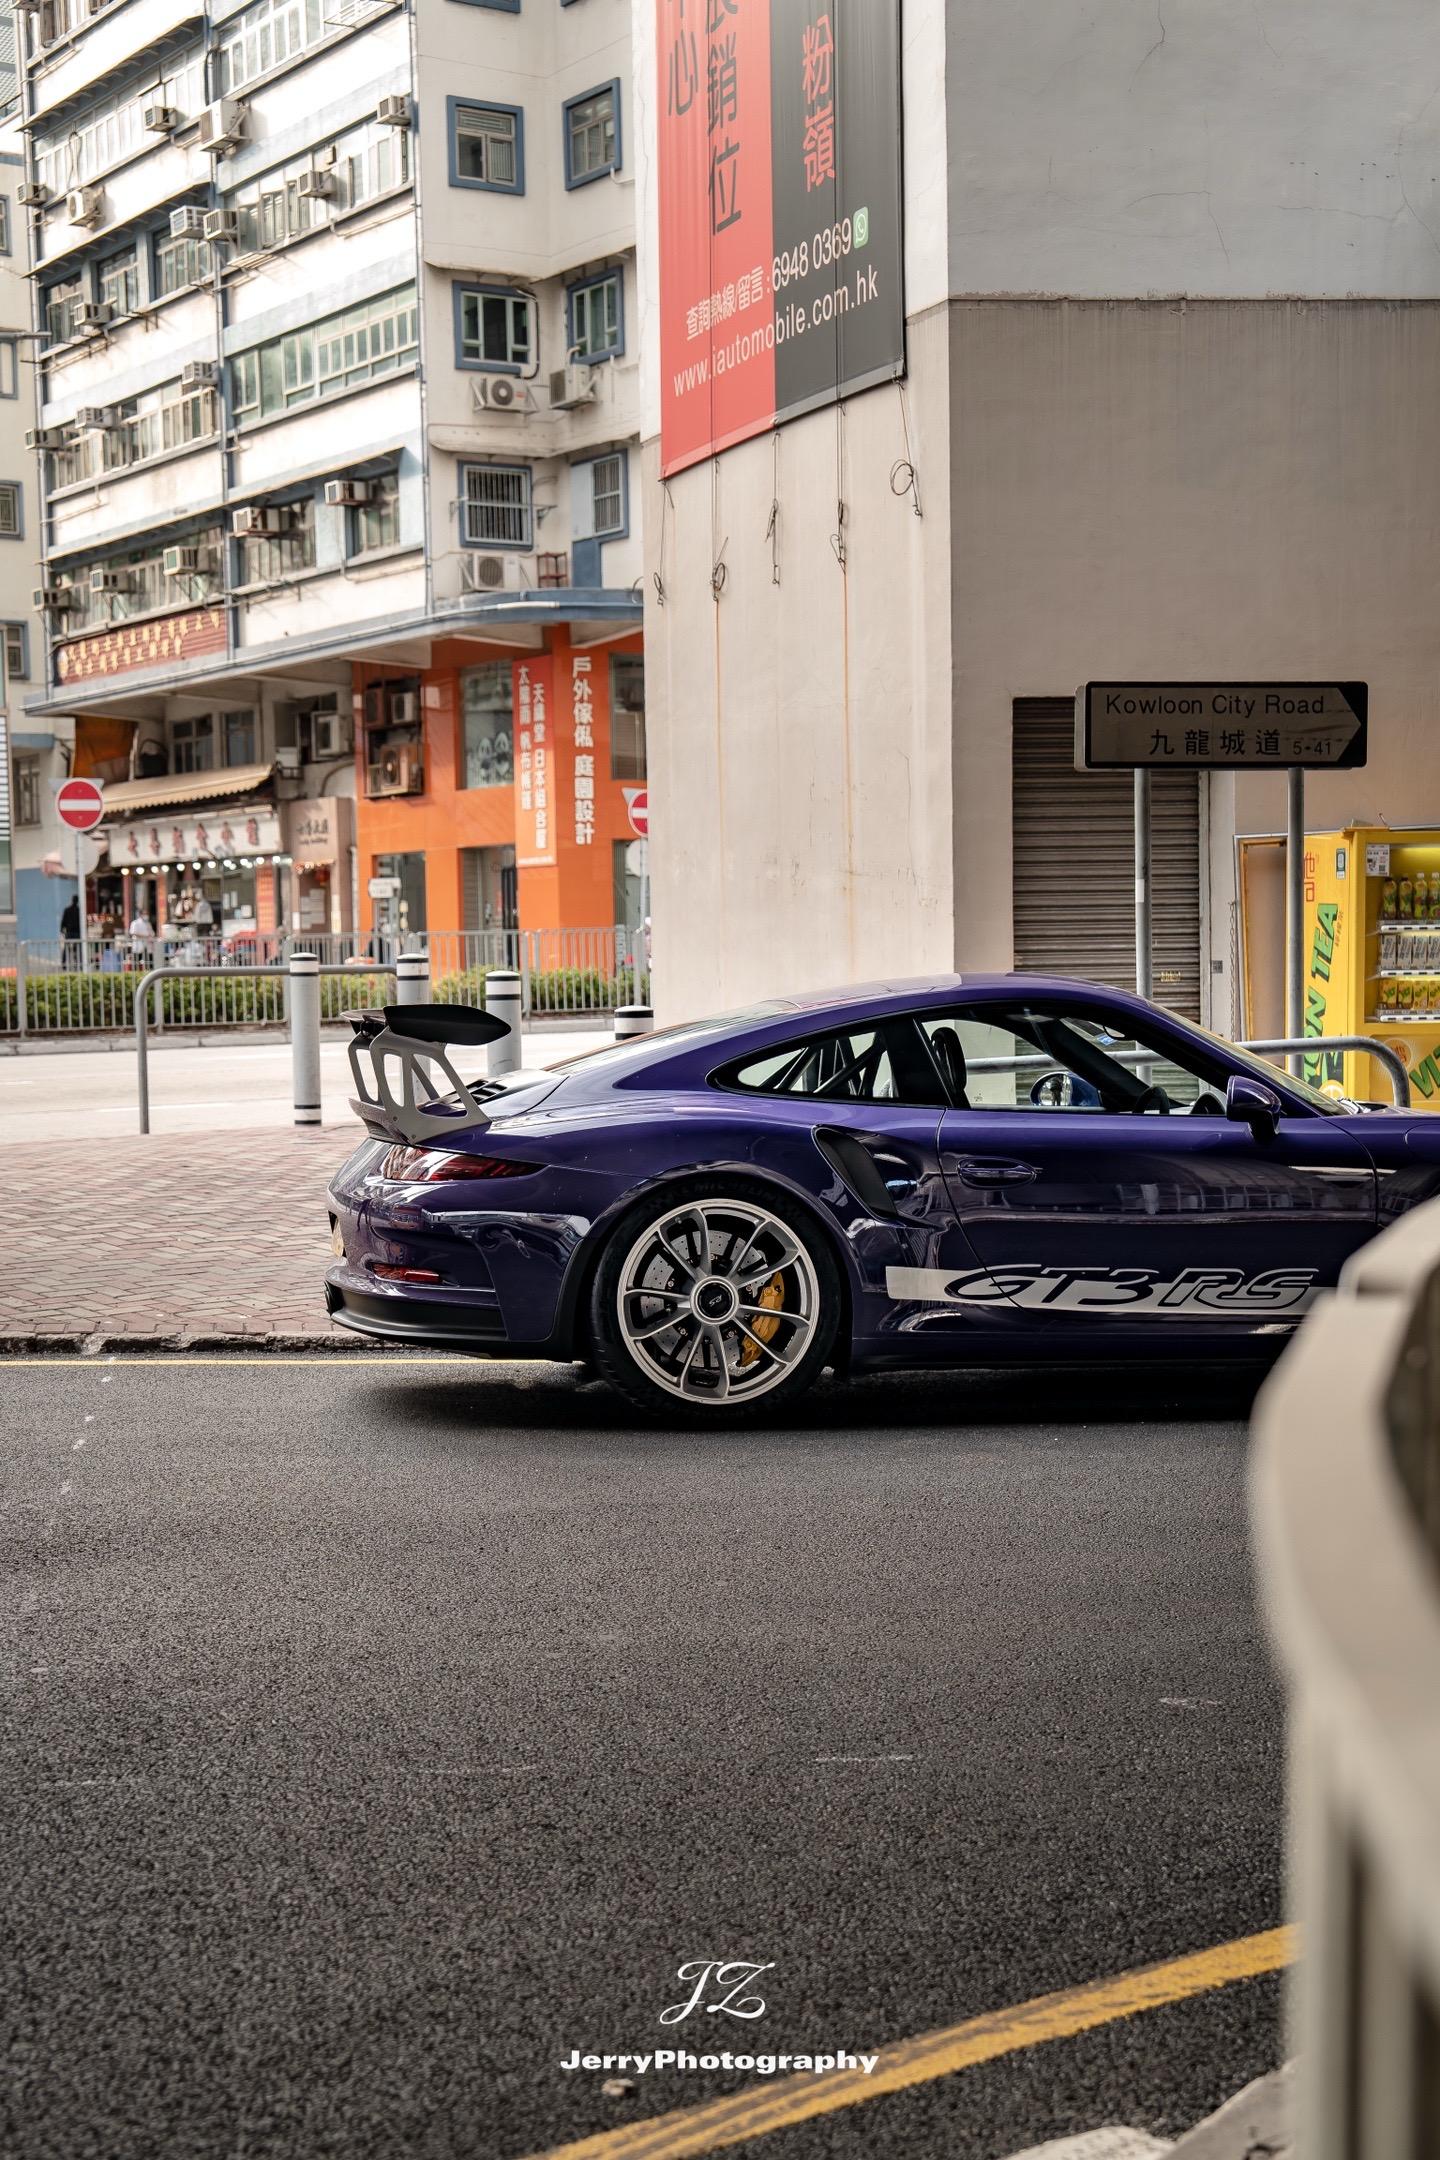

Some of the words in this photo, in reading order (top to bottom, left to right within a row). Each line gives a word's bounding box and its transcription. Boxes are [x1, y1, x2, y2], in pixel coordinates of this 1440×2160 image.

[667, 0, 698, 116] 心
[802, 14, 836, 192] 粉嶺
[772, 240, 808, 292] 6948
[812, 217, 852, 275] 0369
[674, 264, 879, 397] www.iautomobile.com.hk
[1106, 694, 1203, 715] Kowloon
[1212, 694, 1256, 718] City
[1265, 694, 1325, 715] Road
[1150, 728, 1281, 756] 九龍城道
[574, 754, 595, 845] 庭園設計
[1311, 902, 1339, 984] TEA
[1408, 1044, 1440, 1099] VI
[943, 1263, 1160, 1307] GT3
[1158, 1267, 1320, 1310] RS
